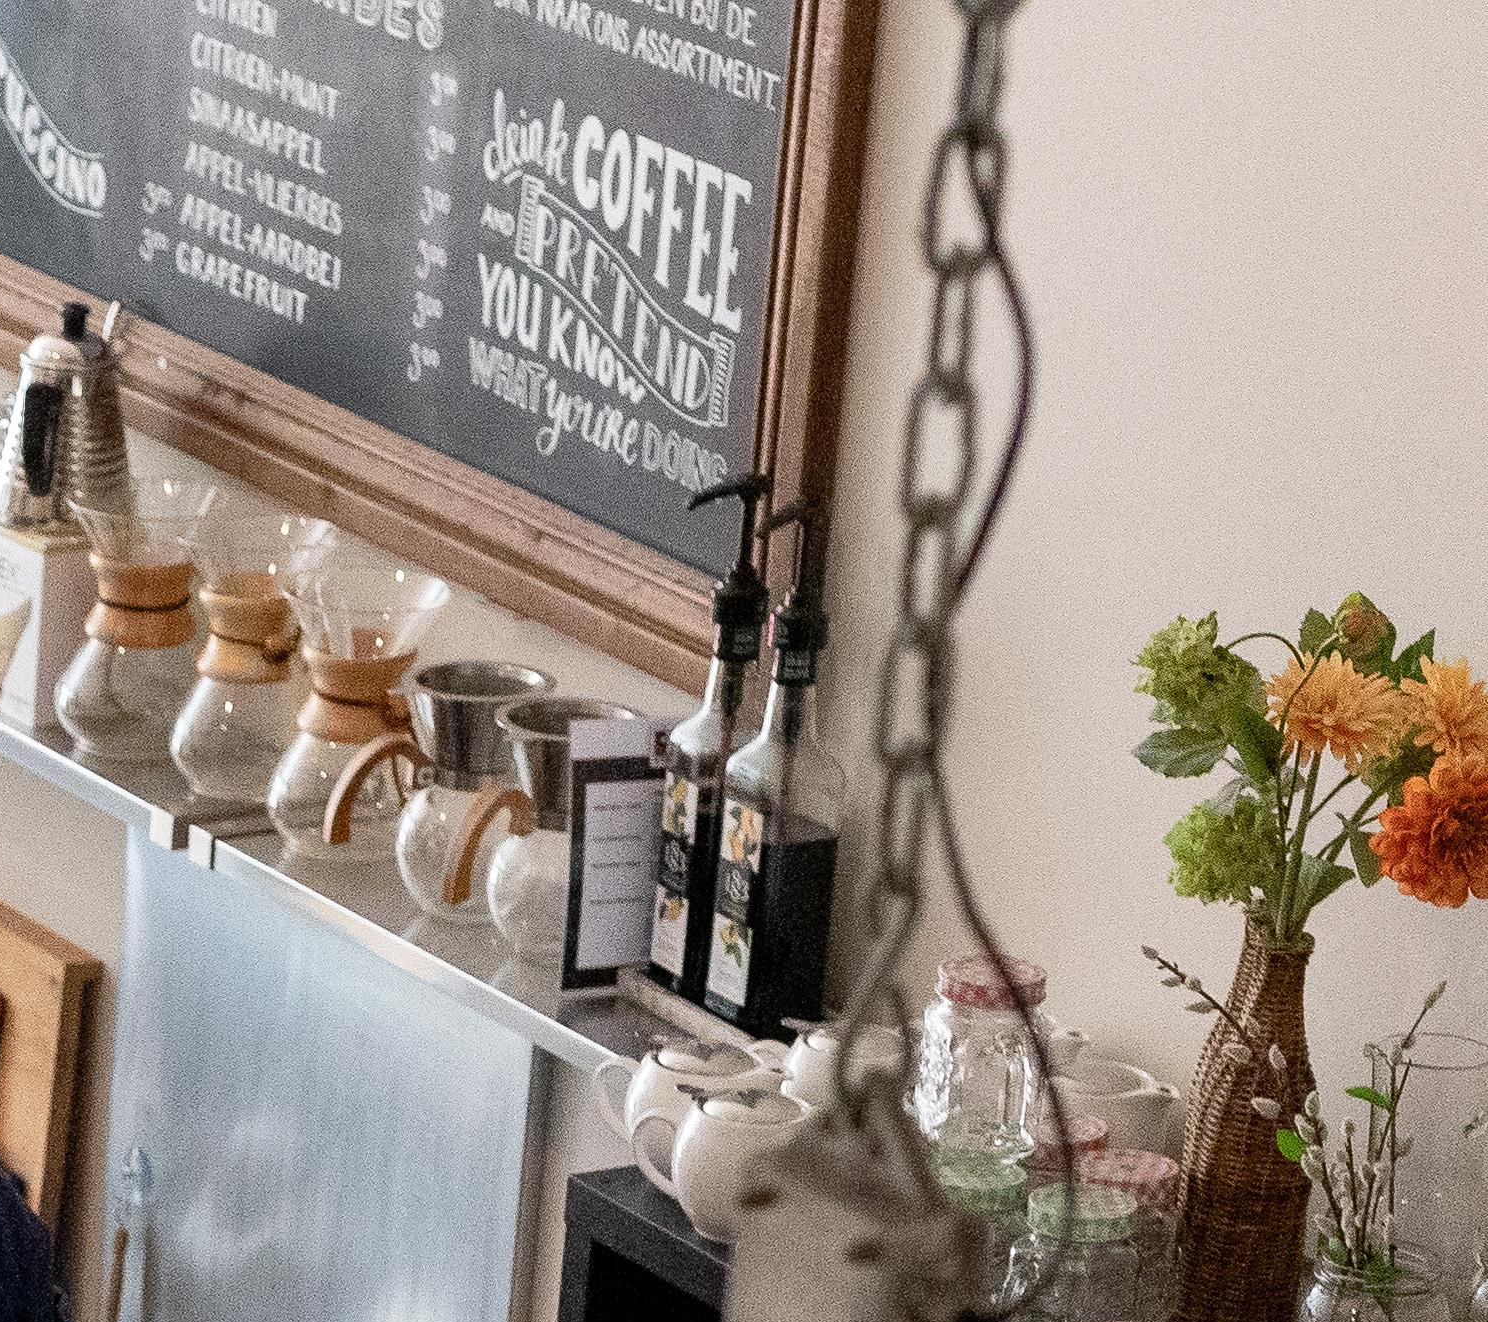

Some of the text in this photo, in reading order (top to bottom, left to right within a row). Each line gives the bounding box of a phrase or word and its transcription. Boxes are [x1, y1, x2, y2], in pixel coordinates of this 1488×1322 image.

[594, 12, 630, 54] ONS
[632, 26, 781, 111] ASSORTIMENT
[726, 1, 757, 47] DE
[183, 142, 344, 236] APPEL-VLIERBES
[573, 114, 753, 333] COFFEE
[175, 241, 309, 324] GRAPEFRUIT
[179, 193, 341, 290] APPEL-AARDBEI
[477, 253, 647, 404] YOU KNOW
[480, 203, 710, 410] AND PRETEND
[469, 337, 547, 413] WHAT
